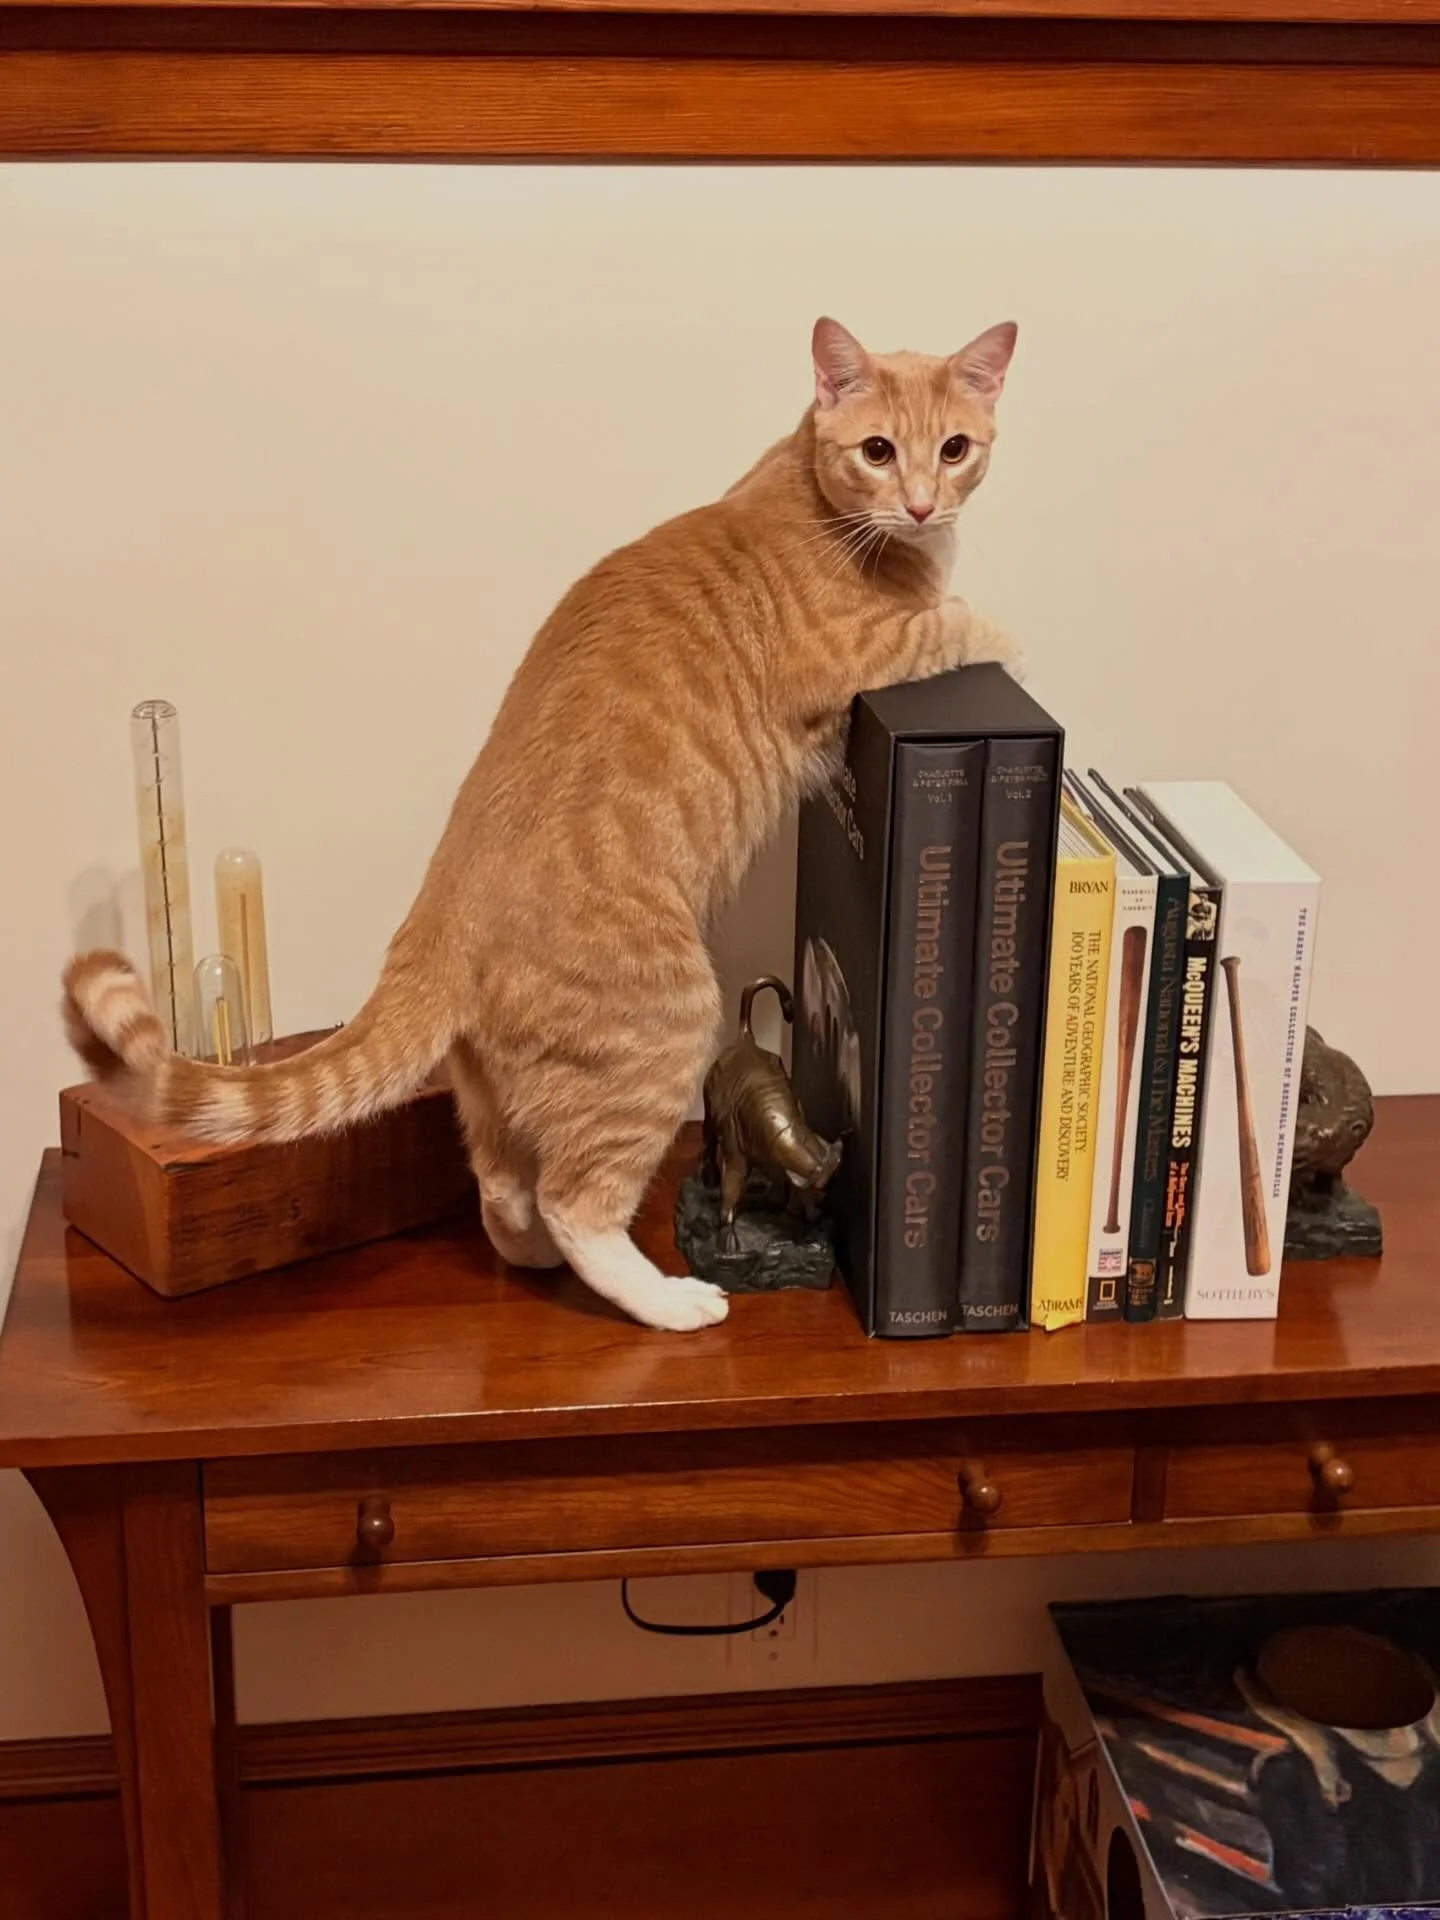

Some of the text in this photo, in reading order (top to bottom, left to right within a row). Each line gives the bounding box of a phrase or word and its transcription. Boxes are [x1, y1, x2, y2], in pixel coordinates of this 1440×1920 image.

[1069, 880, 1109, 894] BRYAN
[904, 845, 952, 1249] Ultimate Collector Cars
[976, 841, 1030, 1242] Ultimate Collector Cars
[1055, 931, 1085, 1182] 100 YEARS OF ADVENTURE AND DISCOVERY
[1074, 929, 1102, 1153] THE NATIONAL GEOGRAPHIC SOCIETY
[1154, 975, 1179, 1055] National
[1171, 956, 1208, 1149] McQUEEN'S MACHINES
[889, 1309, 948, 1324] TASCHEN
[962, 1304, 1019, 1317] TASCHEN
